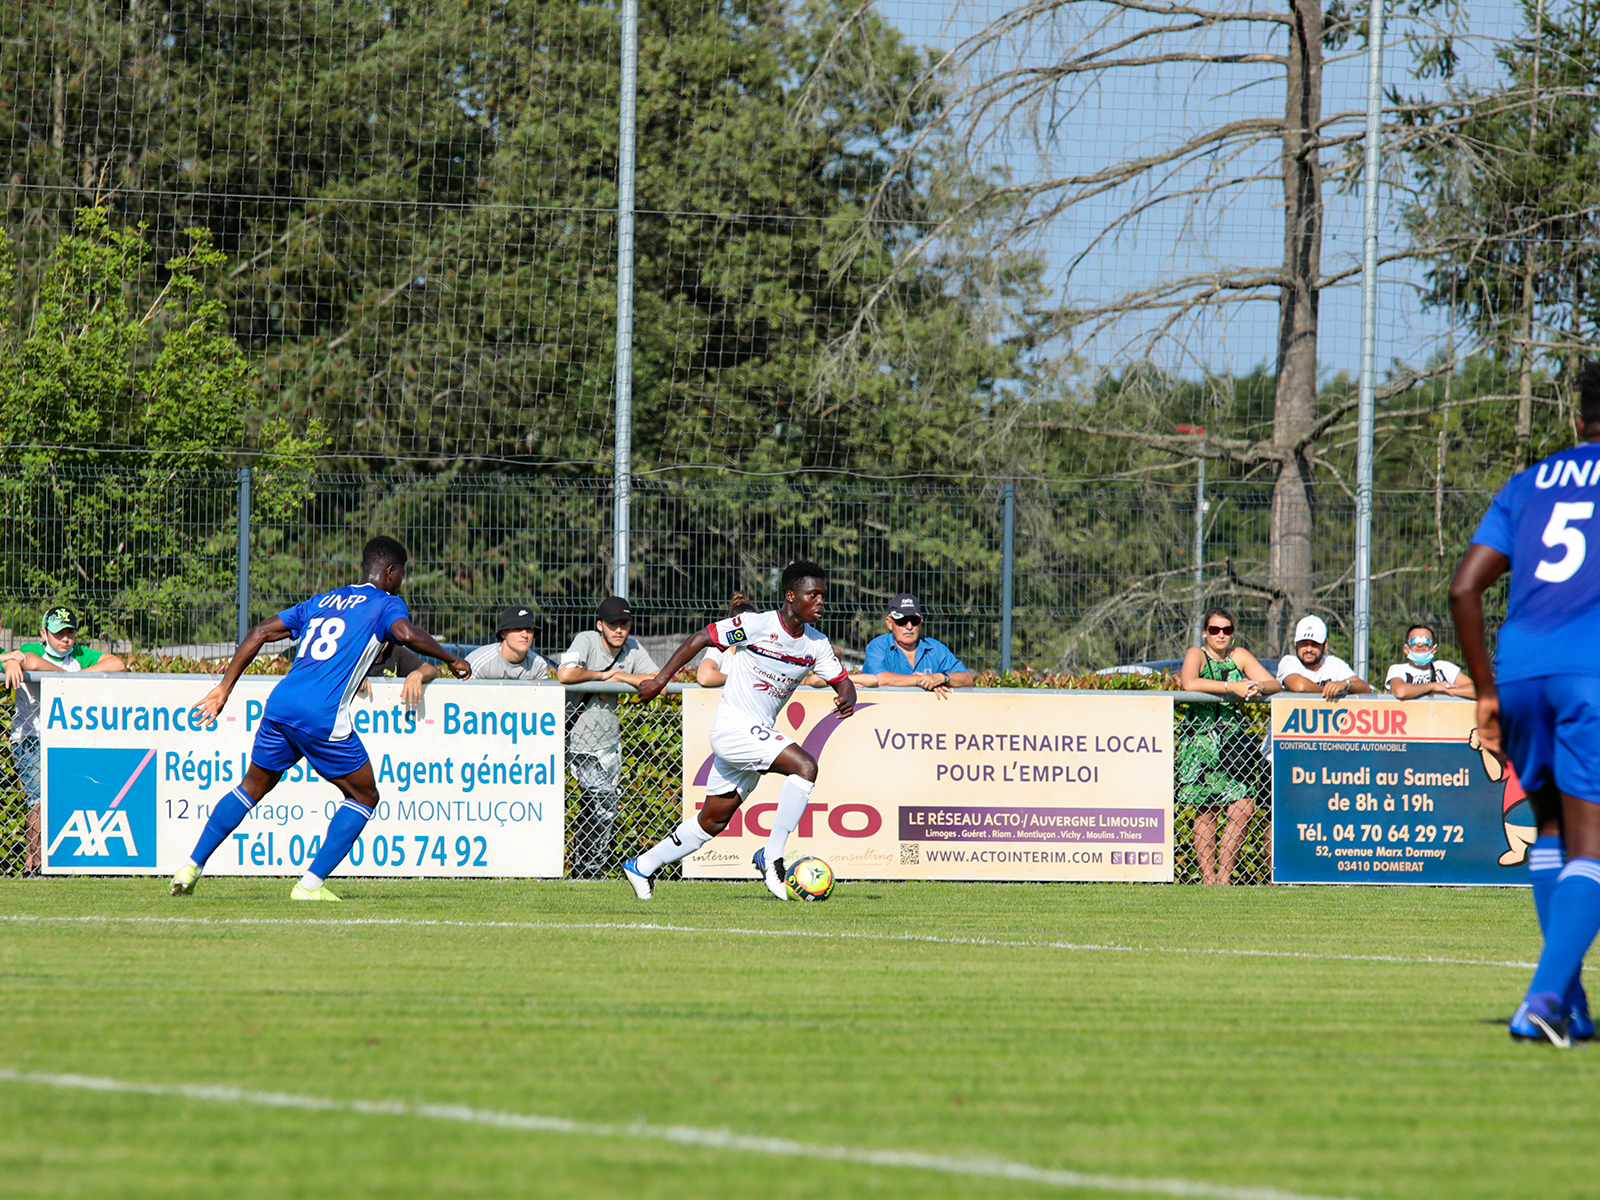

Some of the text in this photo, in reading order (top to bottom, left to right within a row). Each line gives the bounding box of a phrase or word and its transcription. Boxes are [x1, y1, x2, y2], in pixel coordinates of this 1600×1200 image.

[1534, 501, 1595, 583] 5
[318, 593, 367, 611] UNFP
[297, 617, 346, 661] 18
[444, 702, 556, 744] Banque
[1281, 708, 1408, 735] AUTOSUR
[874, 728, 1163, 753] VOTRE PARTENAIRE LOCAL
[1279, 742, 1407, 752] CONTROLE TECHNIQUE AUTOMOBILE
[165, 750, 233, 790] Régis
[378, 753, 454, 792] Agent
[461, 754, 555, 793] général
[936, 764, 996, 782] POUR
[1292, 766, 1470, 787] Du Lundi au Samedi
[165, 799, 190, 819] 12
[249, 803, 304, 825] rago
[397, 800, 543, 827] MONTLUÇON
[1327, 793, 1434, 812] de 8h à 19h
[908, 812, 925, 826] LE
[928, 810, 982, 826] RÉSEAU
[983, 812, 1020, 826] ACTO
[1029, 813, 1096, 827] AUVERGNE
[1099, 814, 1159, 828] LIMOUSIN
[47, 809, 139, 857] AXA
[925, 829, 957, 839] Limoges
[961, 829, 987, 838] Guéret
[992, 830, 1012, 838] Riom
[1016, 830, 1056, 841] Montluçon
[1060, 830, 1081, 841] Vichy
[1086, 830, 1115, 840] Moulins
[1119, 831, 1142, 840] Thiers
[1296, 822, 1464, 843] Tél. 04 70 64 29 72
[233, 831, 283, 867] Tél.
[372, 834, 405, 867] 05
[414, 835, 448, 867] 74
[455, 835, 488, 867] 92
[692, 849, 740, 862] intérim
[829, 847, 894, 866] consulting
[926, 850, 1103, 864] WWW.ACTOINTERIM.COM
[1315, 845, 1446, 860] 52, avenue Marx Dormoy
[1337, 860, 1424, 872] 03410 DOMERAT
